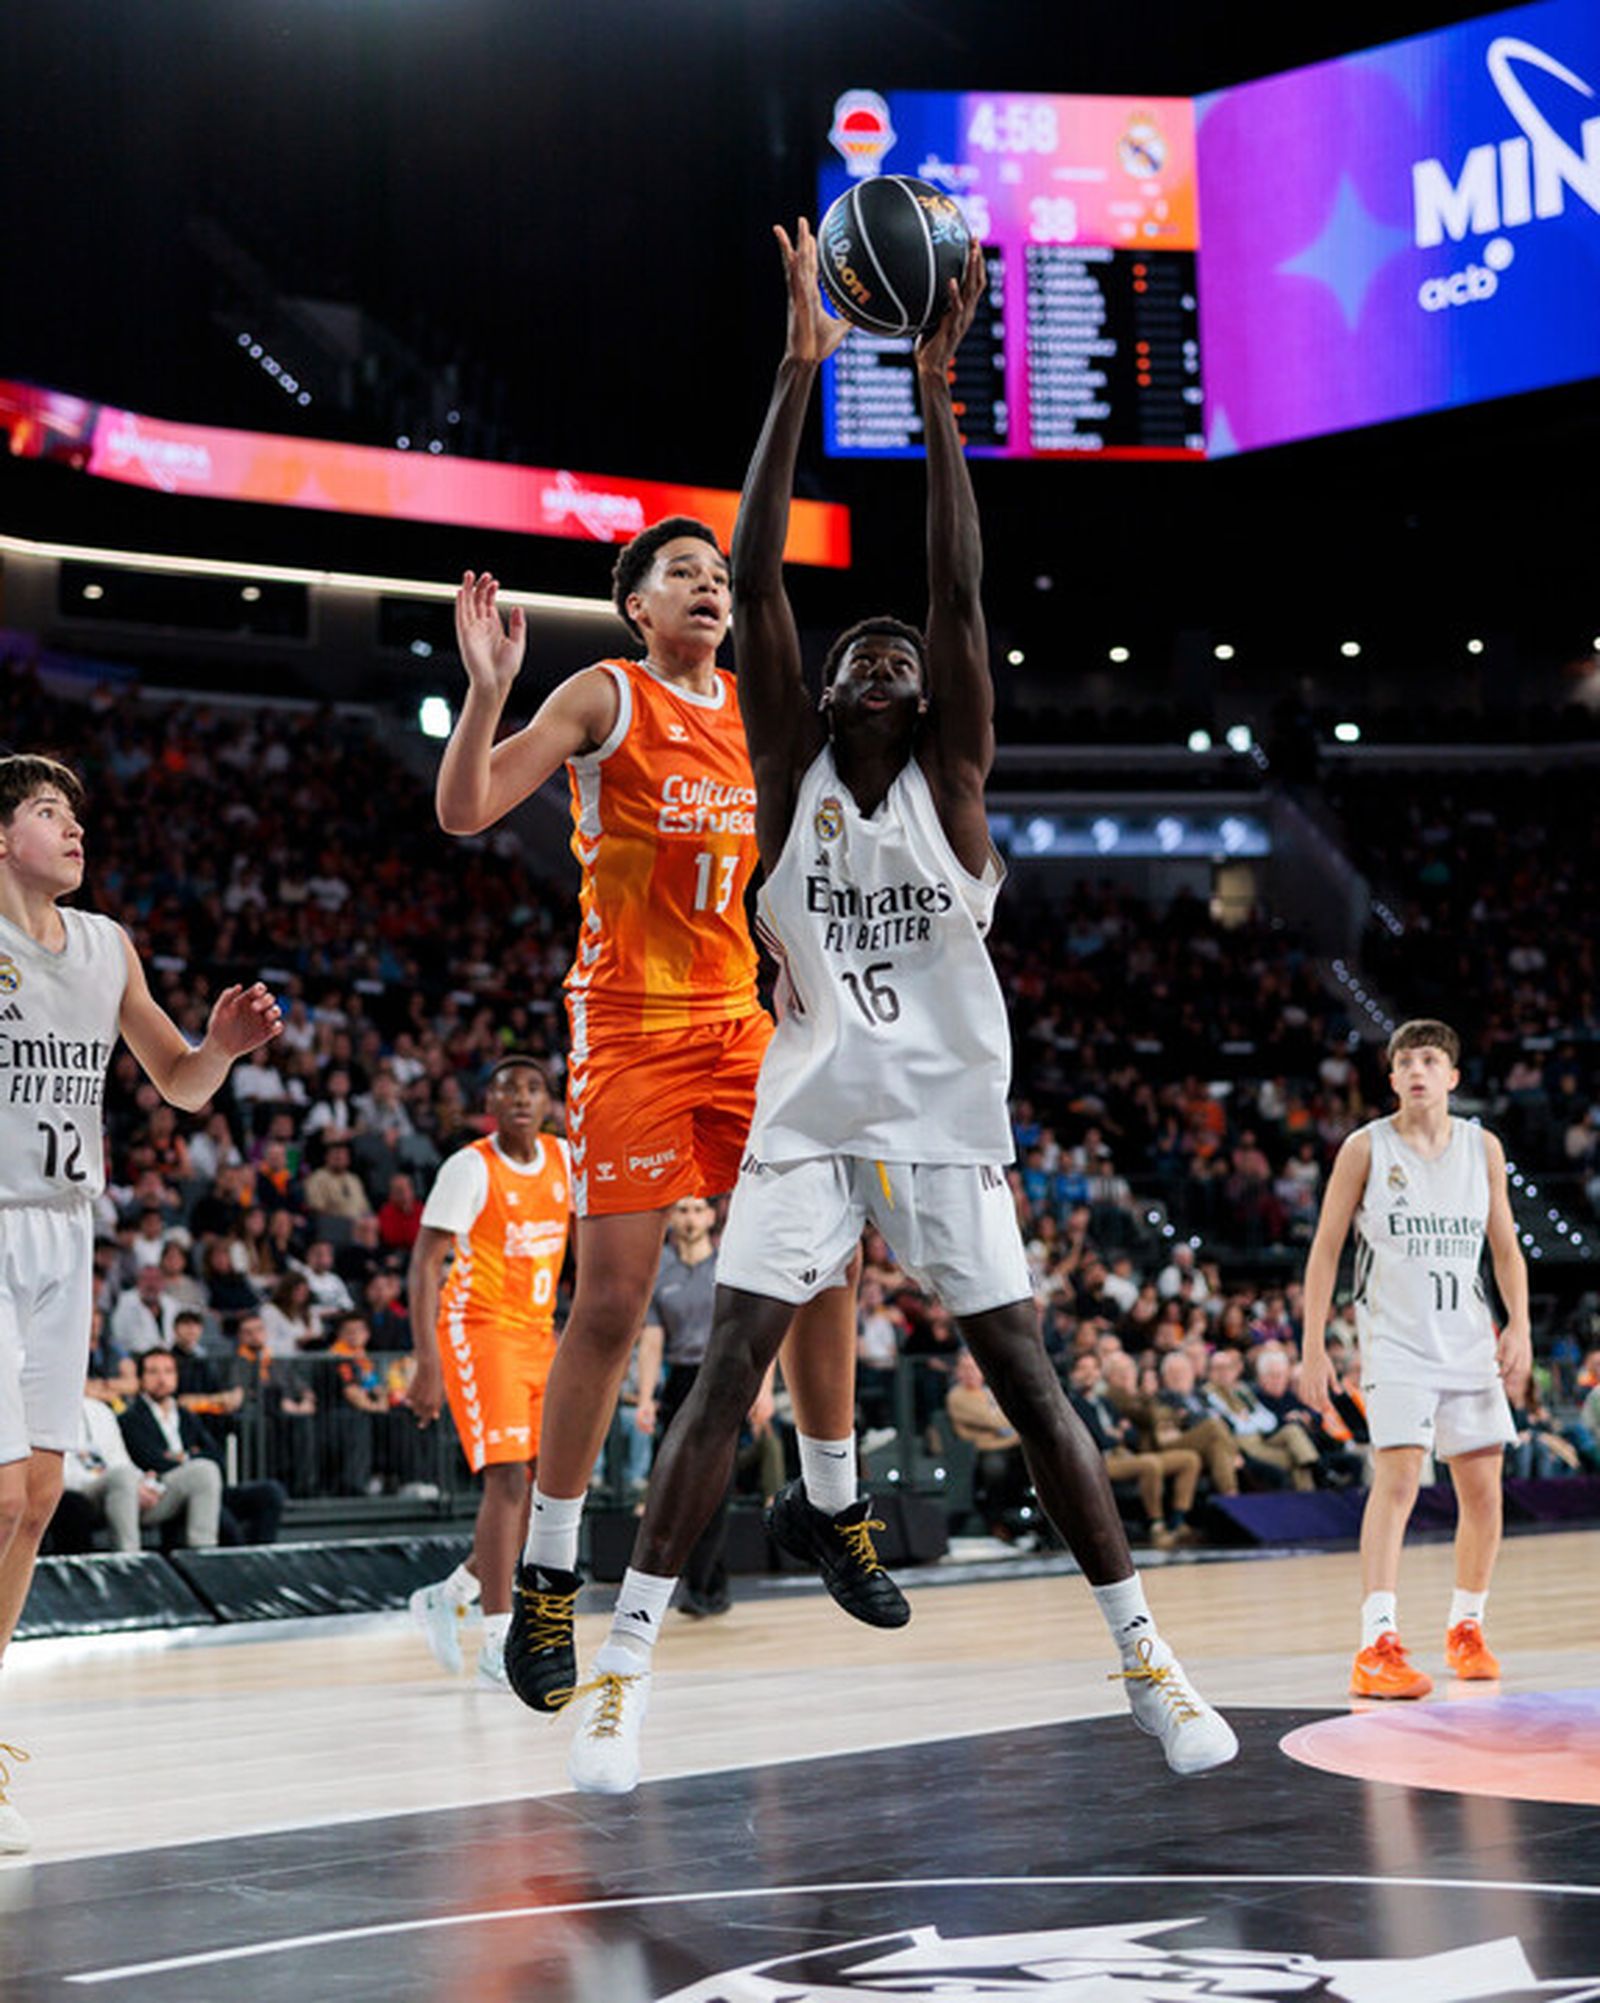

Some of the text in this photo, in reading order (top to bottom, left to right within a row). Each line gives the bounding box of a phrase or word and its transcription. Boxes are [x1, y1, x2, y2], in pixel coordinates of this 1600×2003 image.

[1418, 262, 1498, 312] acb
[661, 775, 758, 807] Cultura
[694, 853, 740, 914] 13
[855, 916, 931, 950] BETTER
[842, 962, 899, 1026] 16
[10, 1074, 46, 1103] FLY
[38, 1121, 86, 1181] 12
[1407, 1238, 1430, 1257] FLY
[1428, 1270, 1458, 1311] 11
